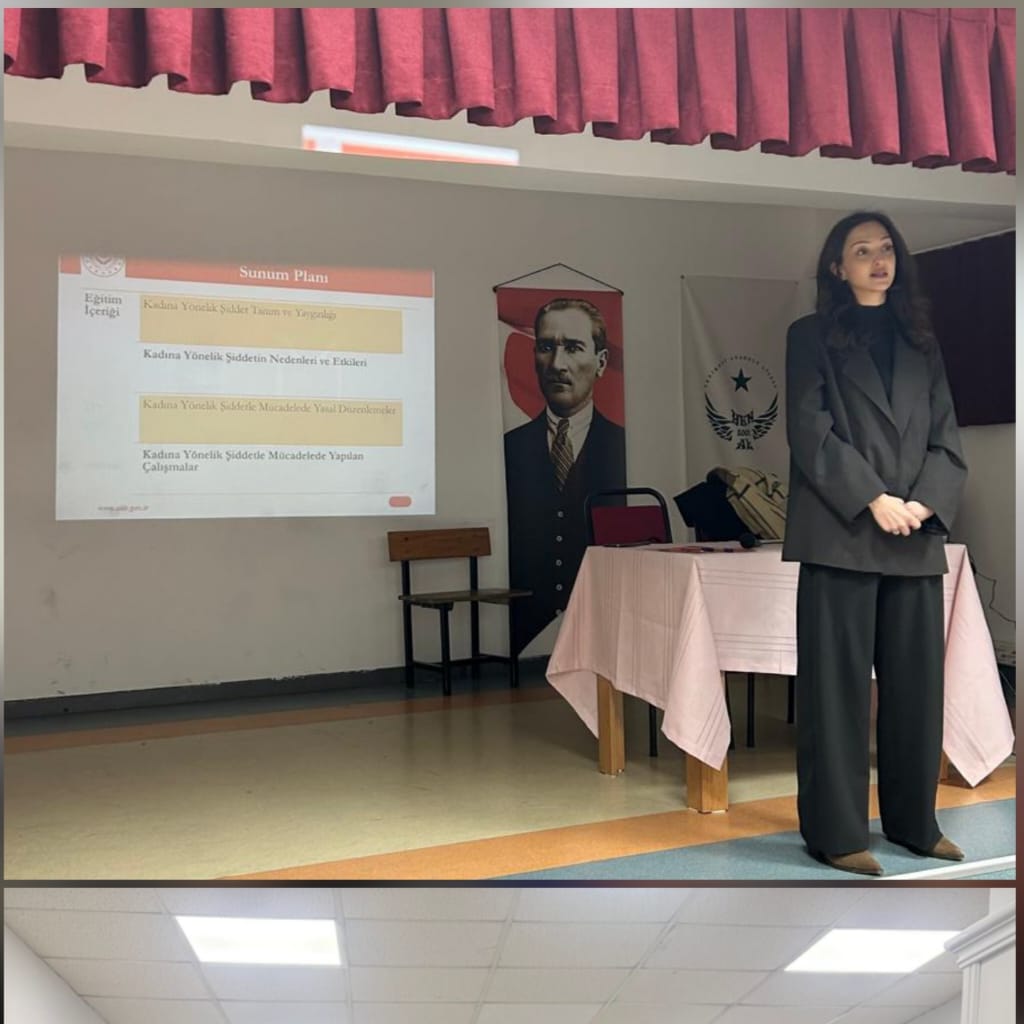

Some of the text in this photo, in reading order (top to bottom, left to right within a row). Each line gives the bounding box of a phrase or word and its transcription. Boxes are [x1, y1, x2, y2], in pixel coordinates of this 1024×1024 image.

[239, 265, 289, 281] Sunum
[84, 292, 123, 305] Eğitim
[143, 298, 178, 311] Kadına
[143, 348, 367, 368] Kadına Yönelik Şiddetin Nedenleri ve Etkileri
[142, 399, 178, 410] Kadına
[142, 449, 180, 460] Kadına
[182, 449, 223, 461] Yönelik
[225, 450, 266, 462] Şiddetle
[268, 451, 327, 461] Mücadelede
[142, 462, 199, 474] Çalışmalar
